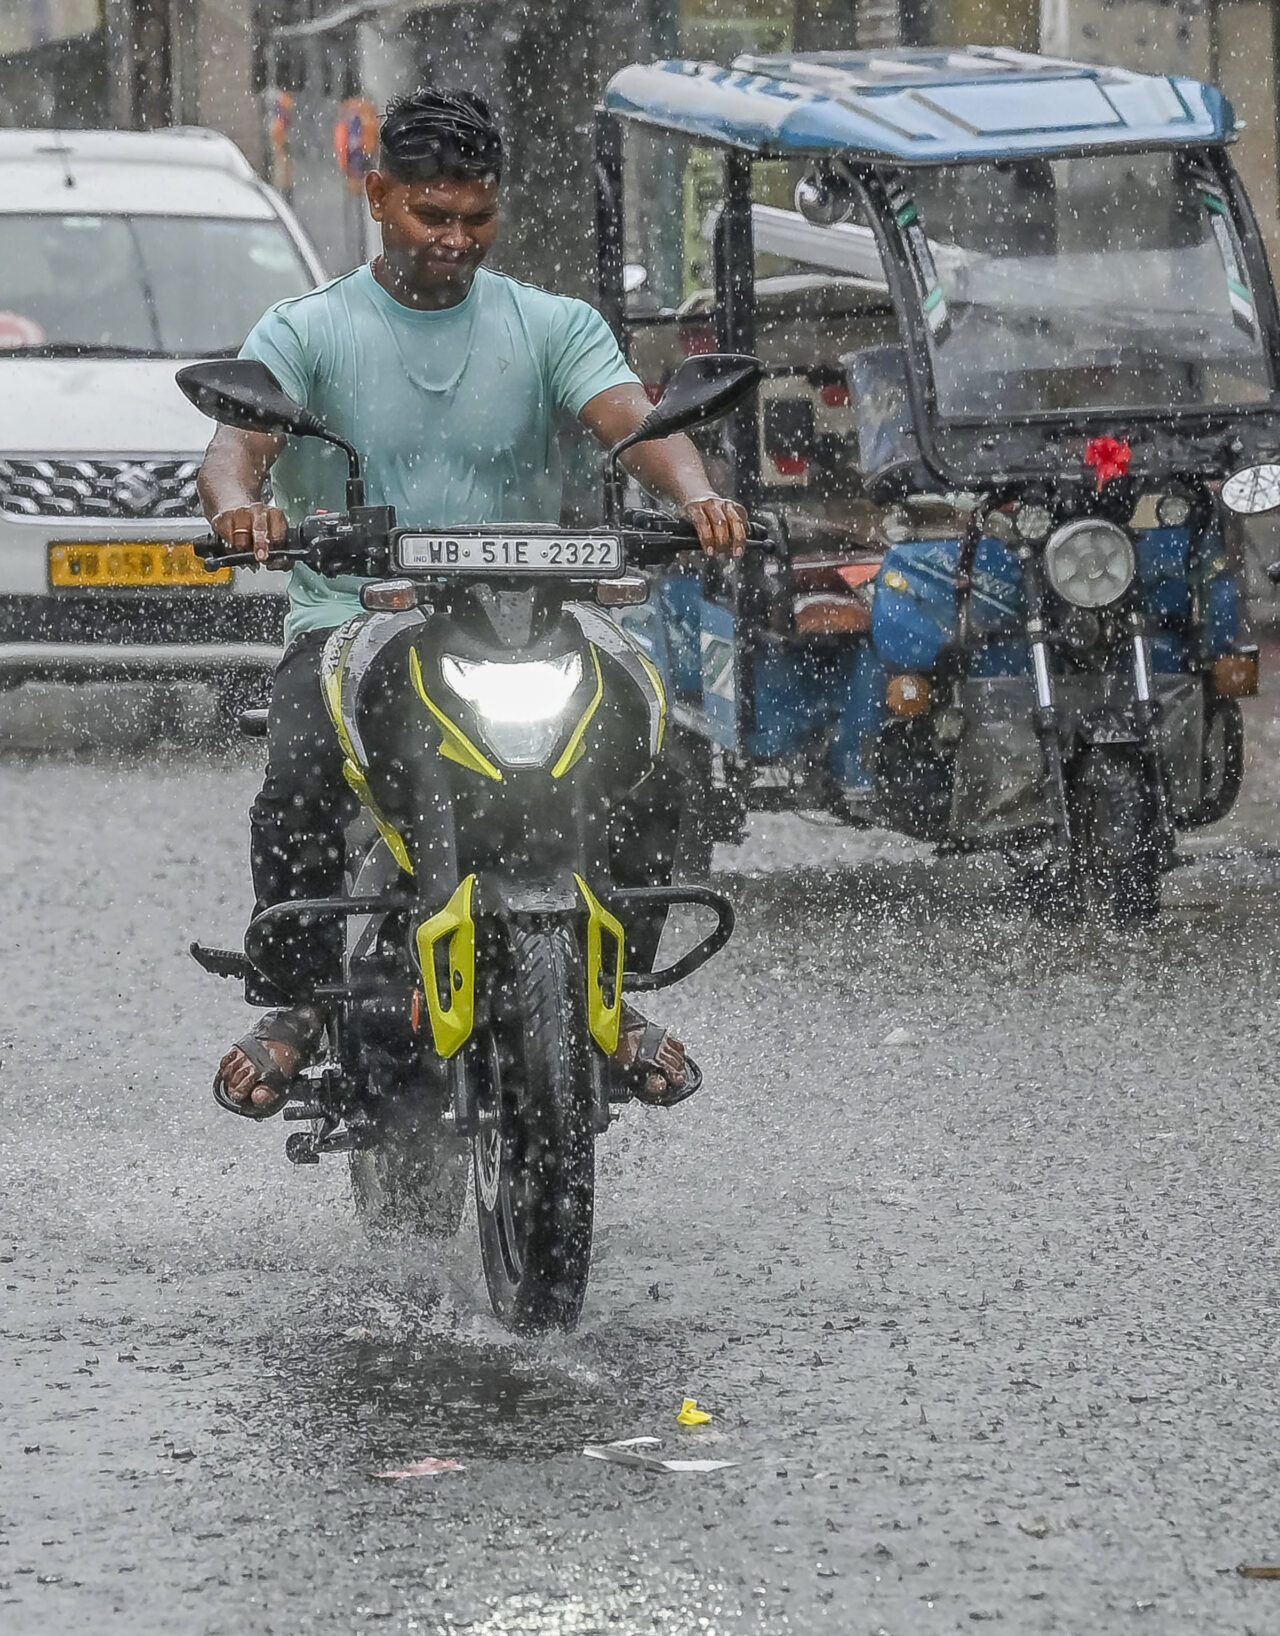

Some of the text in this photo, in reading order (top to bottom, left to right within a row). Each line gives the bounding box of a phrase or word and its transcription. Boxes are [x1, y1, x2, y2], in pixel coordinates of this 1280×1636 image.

[429, 541, 612, 565] WB 51E 2322
